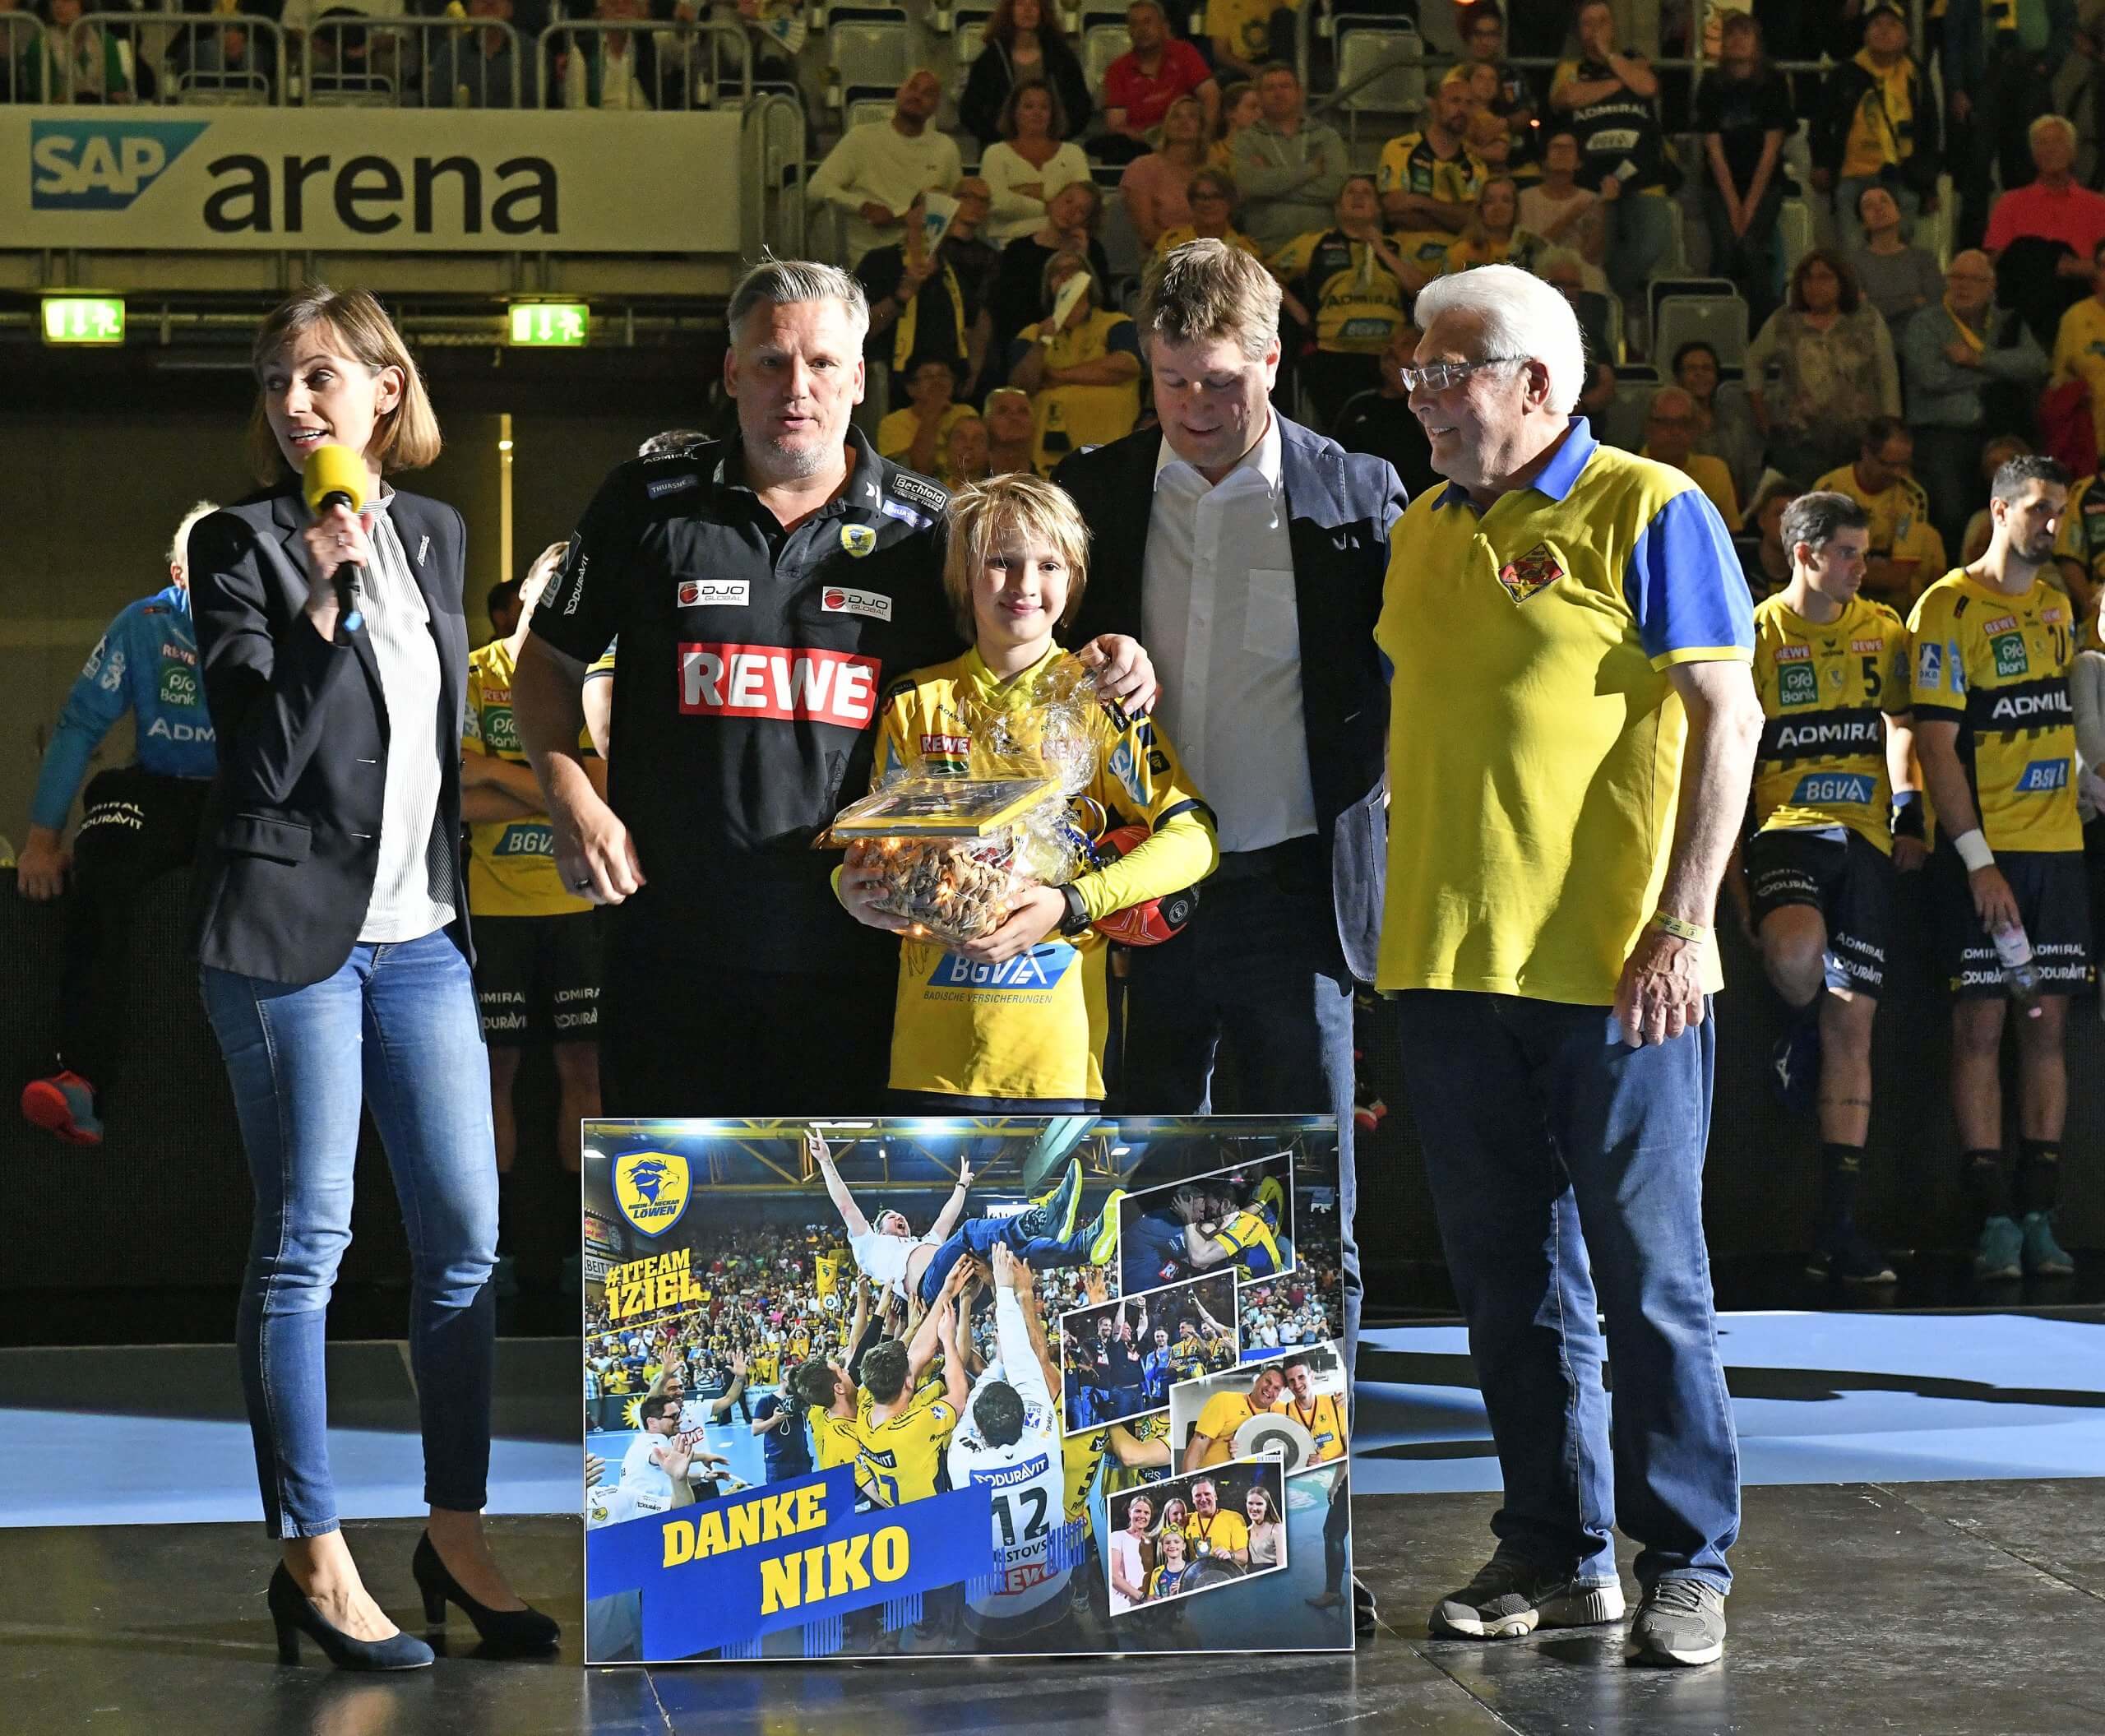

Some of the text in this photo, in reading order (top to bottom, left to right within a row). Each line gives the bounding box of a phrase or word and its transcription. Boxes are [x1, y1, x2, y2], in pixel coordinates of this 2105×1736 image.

[33, 136, 559, 234] SAP arena
[571, 553, 590, 604] DURAVIT
[701, 586, 744, 595] DJO
[848, 594, 889, 610] DJO
[851, 604, 886, 617] GLOBAL
[1852, 639, 1883, 652] REWE
[682, 651, 874, 720] REWE
[1862, 655, 1881, 697] 5
[160, 688, 196, 706] Bank
[1782, 689, 1816, 703] Bank
[922, 736, 969, 754] REWE
[507, 832, 553, 853] BGV
[1835, 931, 1885, 963] ADMIRAL
[923, 990, 1052, 1004] BADISCHE VERSICHERUNGEN
[633, 1206, 677, 1219] LÖWEN
[604, 1248, 691, 1289] #1TEAM
[605, 1268, 701, 1320] 1ZIEL
[994, 1459, 1047, 1486] DURAVIT
[662, 1483, 827, 1568] DANKE
[992, 1486, 1050, 1547] 12
[760, 1525, 910, 1616] NIKO
